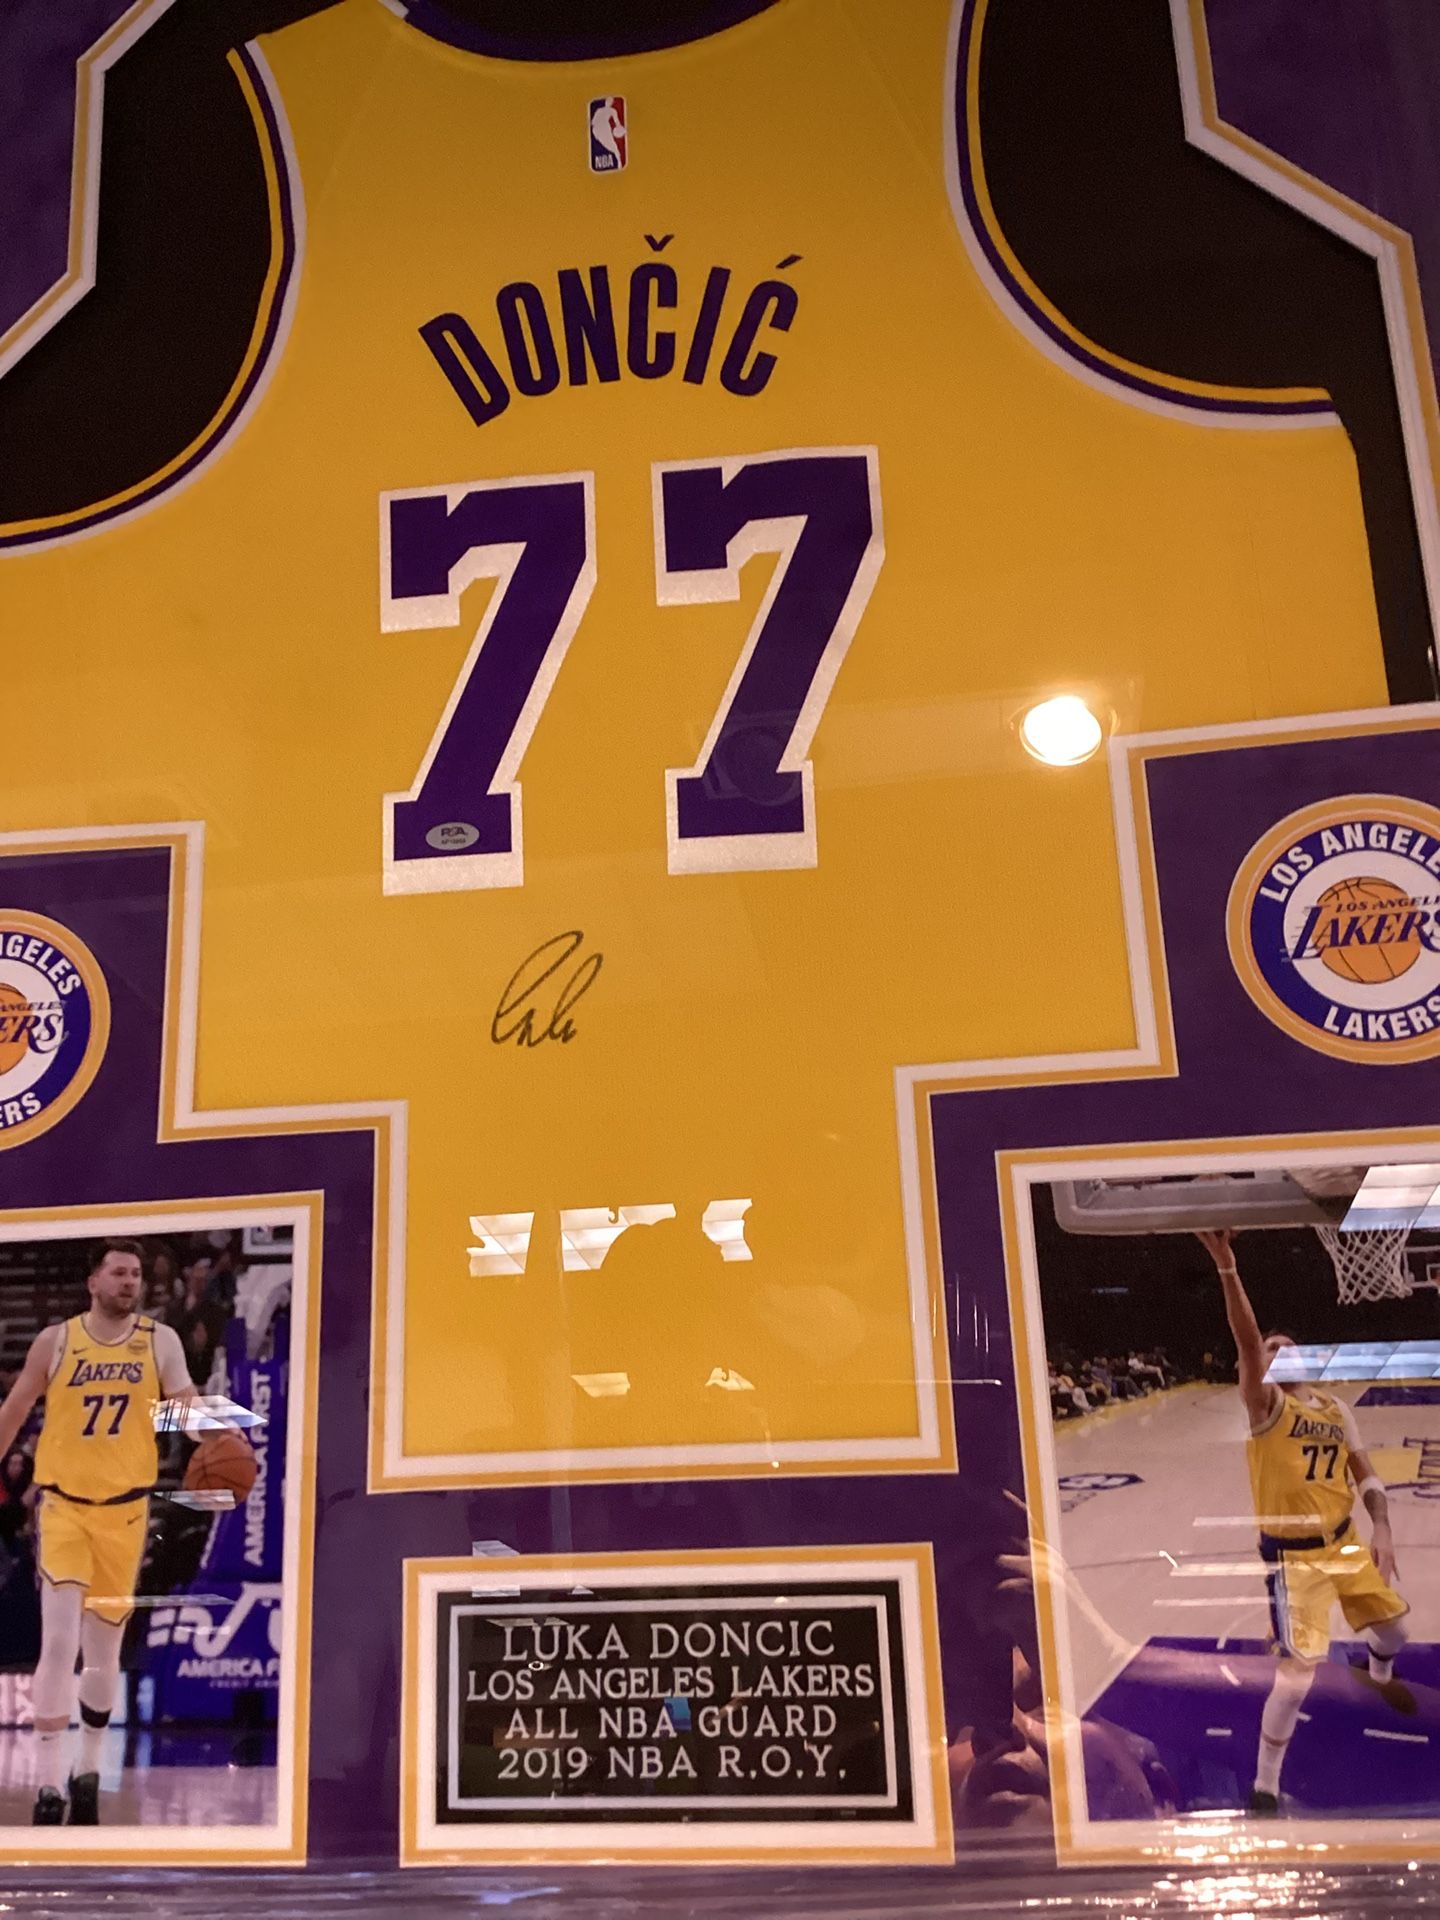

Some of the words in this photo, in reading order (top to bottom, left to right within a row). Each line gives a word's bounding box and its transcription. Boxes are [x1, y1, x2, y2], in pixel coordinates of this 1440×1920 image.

[595, 154, 614, 169] NBA
[418, 234, 803, 427] DONČIĆ
[379, 445, 886, 896] 77
[1259, 846, 1313, 902] LOS
[1336, 900, 1368, 913] LOS
[66, 1359, 143, 1387] LAKERS
[82, 1394, 129, 1436] 77
[1288, 1414, 1344, 1442] LAKERS
[1302, 1445, 1339, 1480] 77
[503, 1622, 629, 1661] LUKA
[649, 1620, 834, 1659] DONCIC
[467, 1669, 535, 1701] LOS
[550, 1666, 715, 1699] ANGELES
[731, 1663, 875, 1698] LAKERS
[505, 1707, 579, 1740] ALL
[598, 1705, 677, 1739] NBA
[698, 1704, 837, 1738] GUARD
[498, 1746, 589, 1780] 2019
[607, 1744, 698, 1779] NBA
[718, 1744, 847, 1780] R.O.Y.
